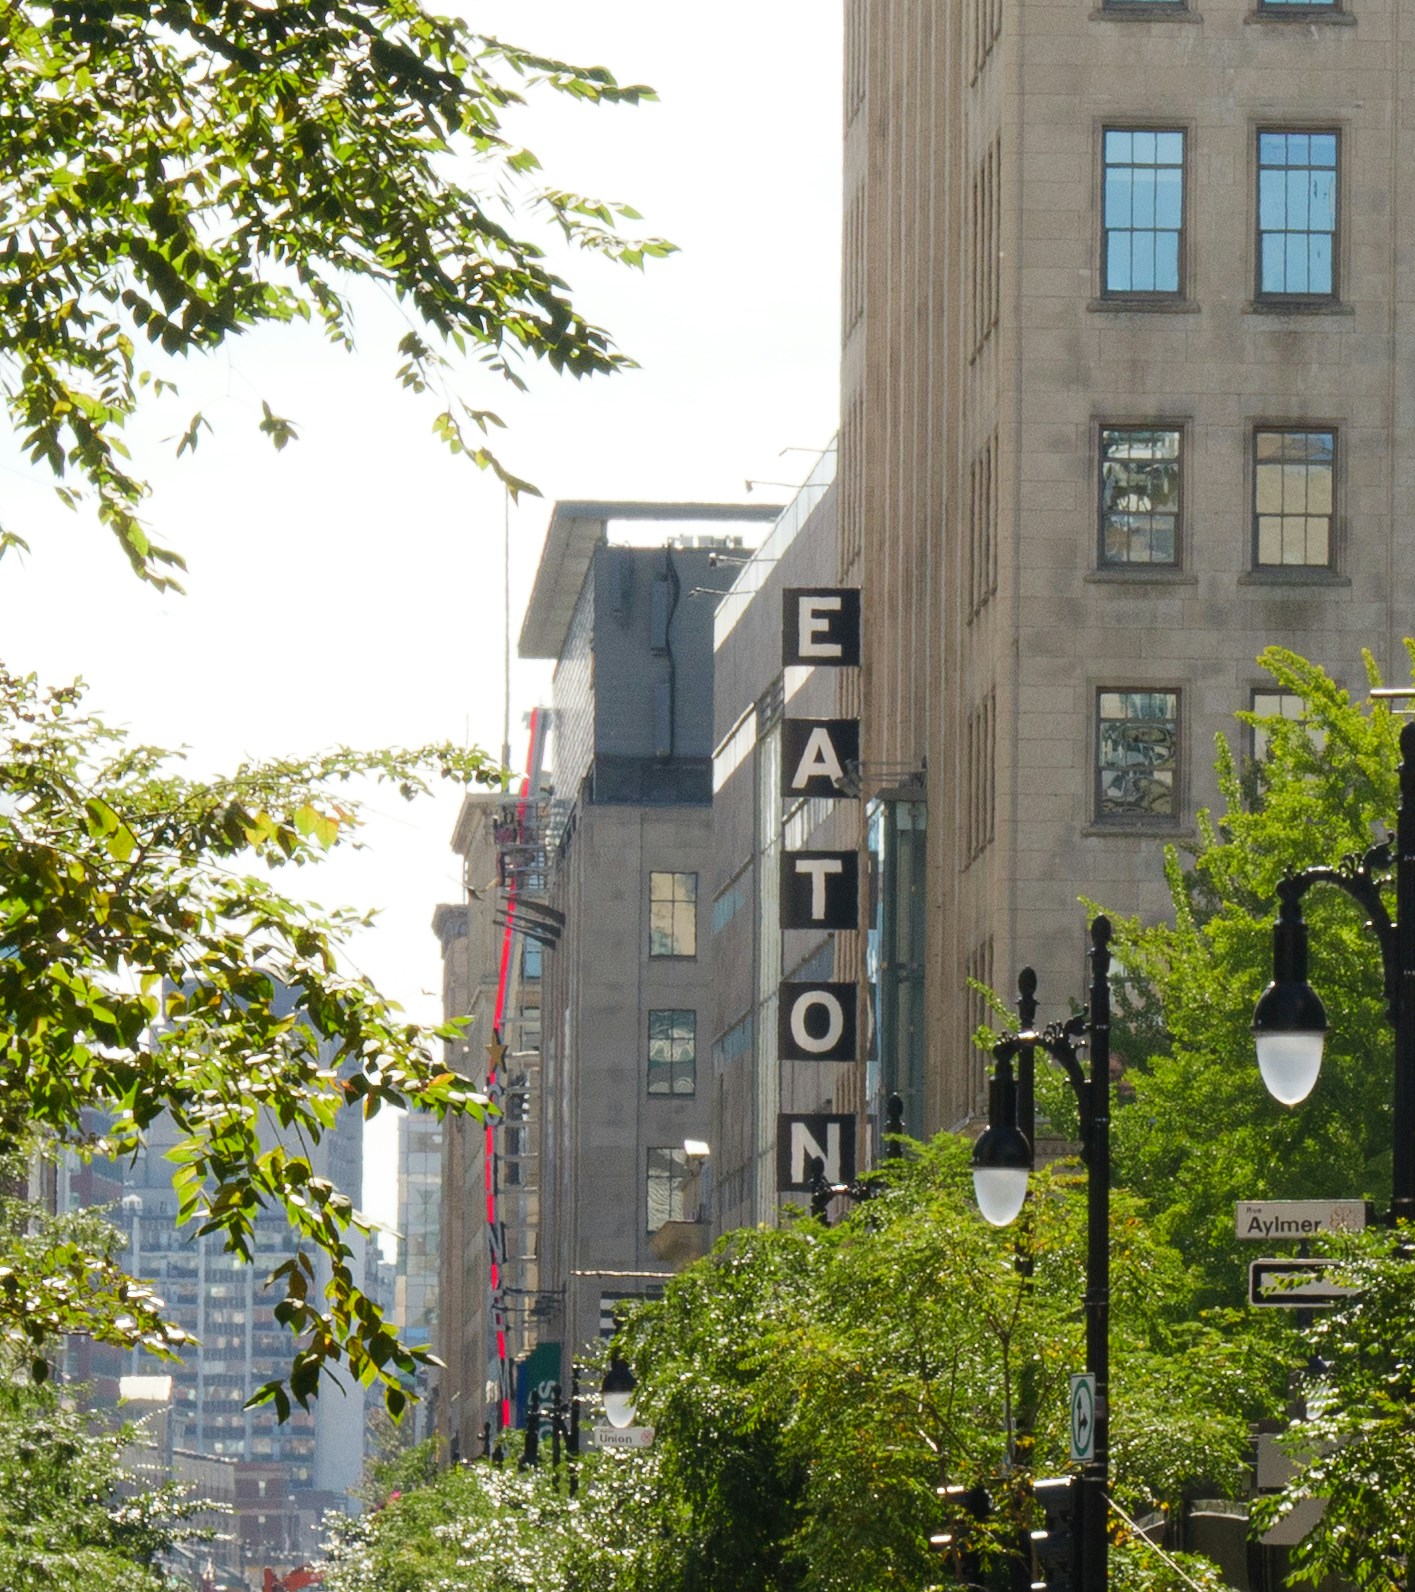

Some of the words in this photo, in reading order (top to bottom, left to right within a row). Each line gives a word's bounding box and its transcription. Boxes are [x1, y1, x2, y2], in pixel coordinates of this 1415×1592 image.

[789, 597, 848, 1184] EATON
[1247, 1215, 1323, 1237] Aylmer
[600, 1433, 632, 1444] Union
